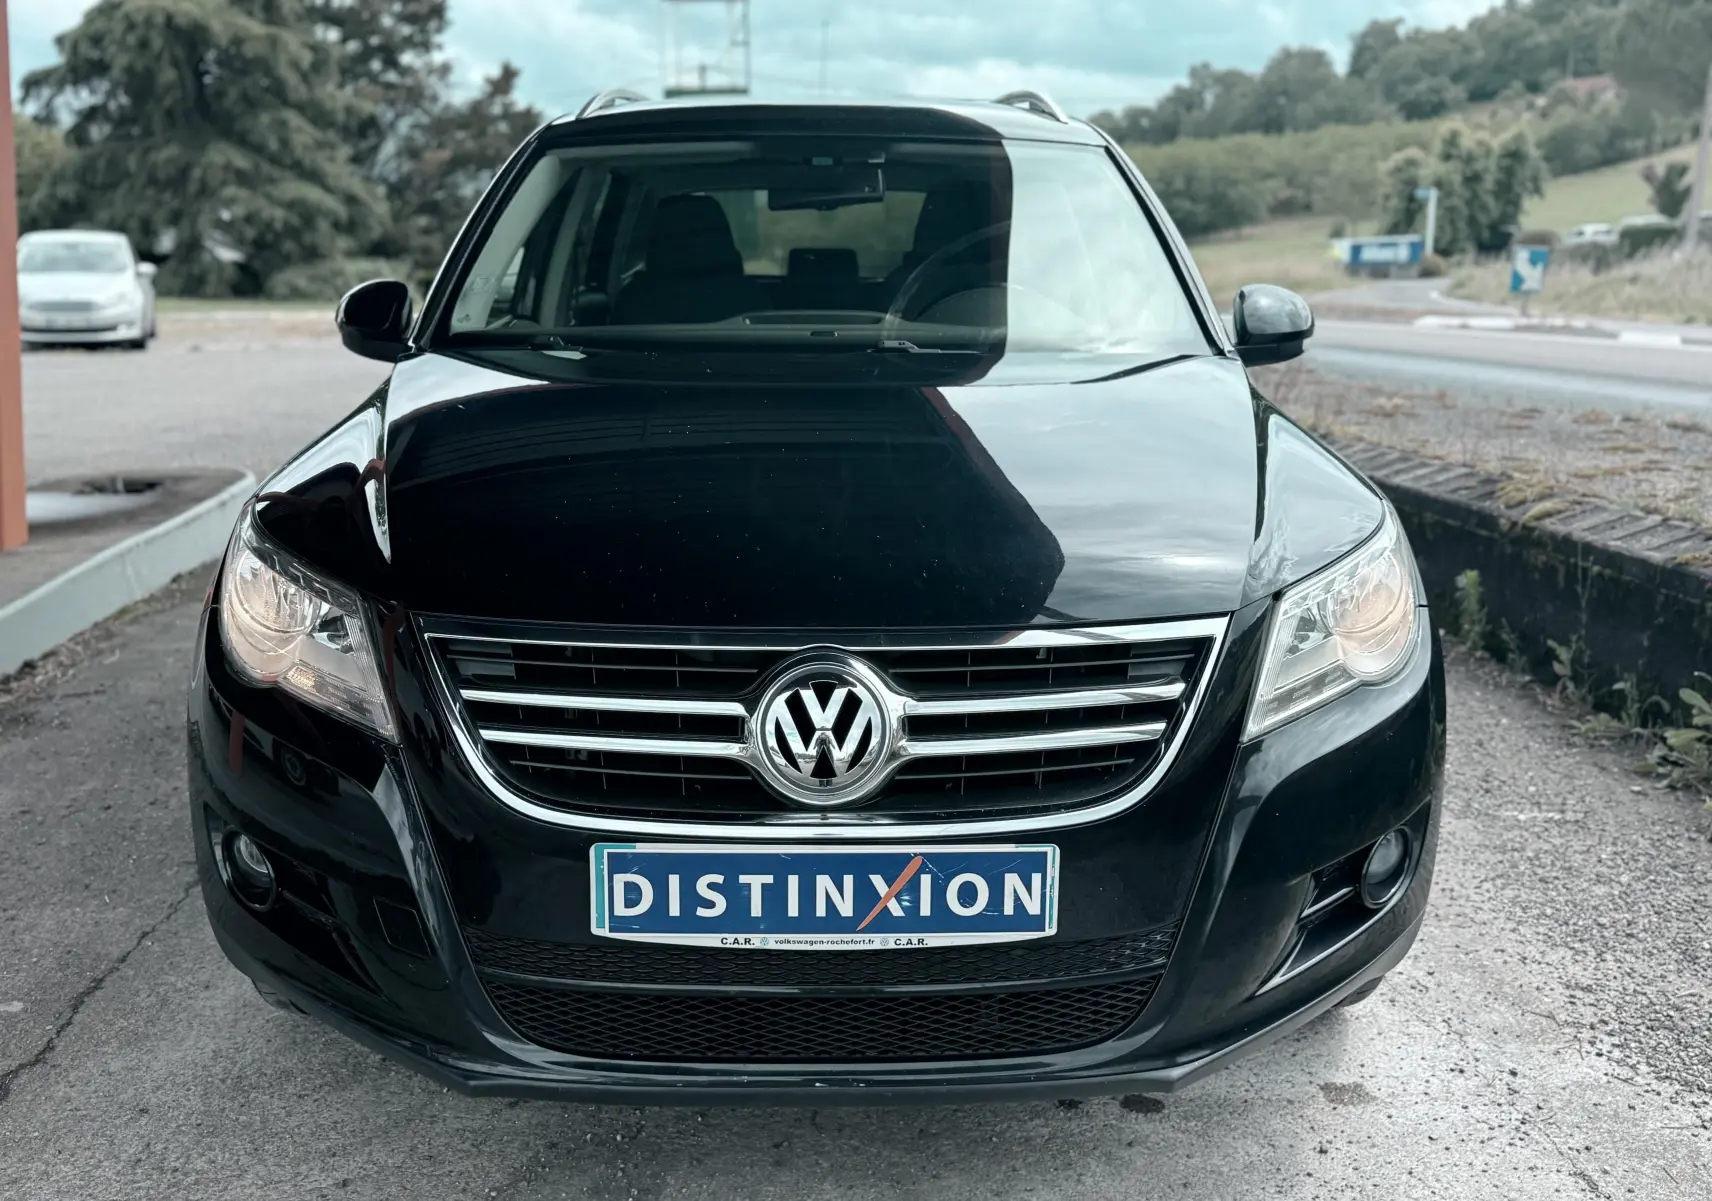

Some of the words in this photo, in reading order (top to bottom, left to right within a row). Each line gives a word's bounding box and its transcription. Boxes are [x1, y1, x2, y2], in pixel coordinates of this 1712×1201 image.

[613, 857, 1041, 931] DISTINXION
[720, 937, 755, 946] C.A.R.
[774, 938, 875, 946] volkswagen-rochefort.fr
[894, 938, 928, 946] C.A.R.
